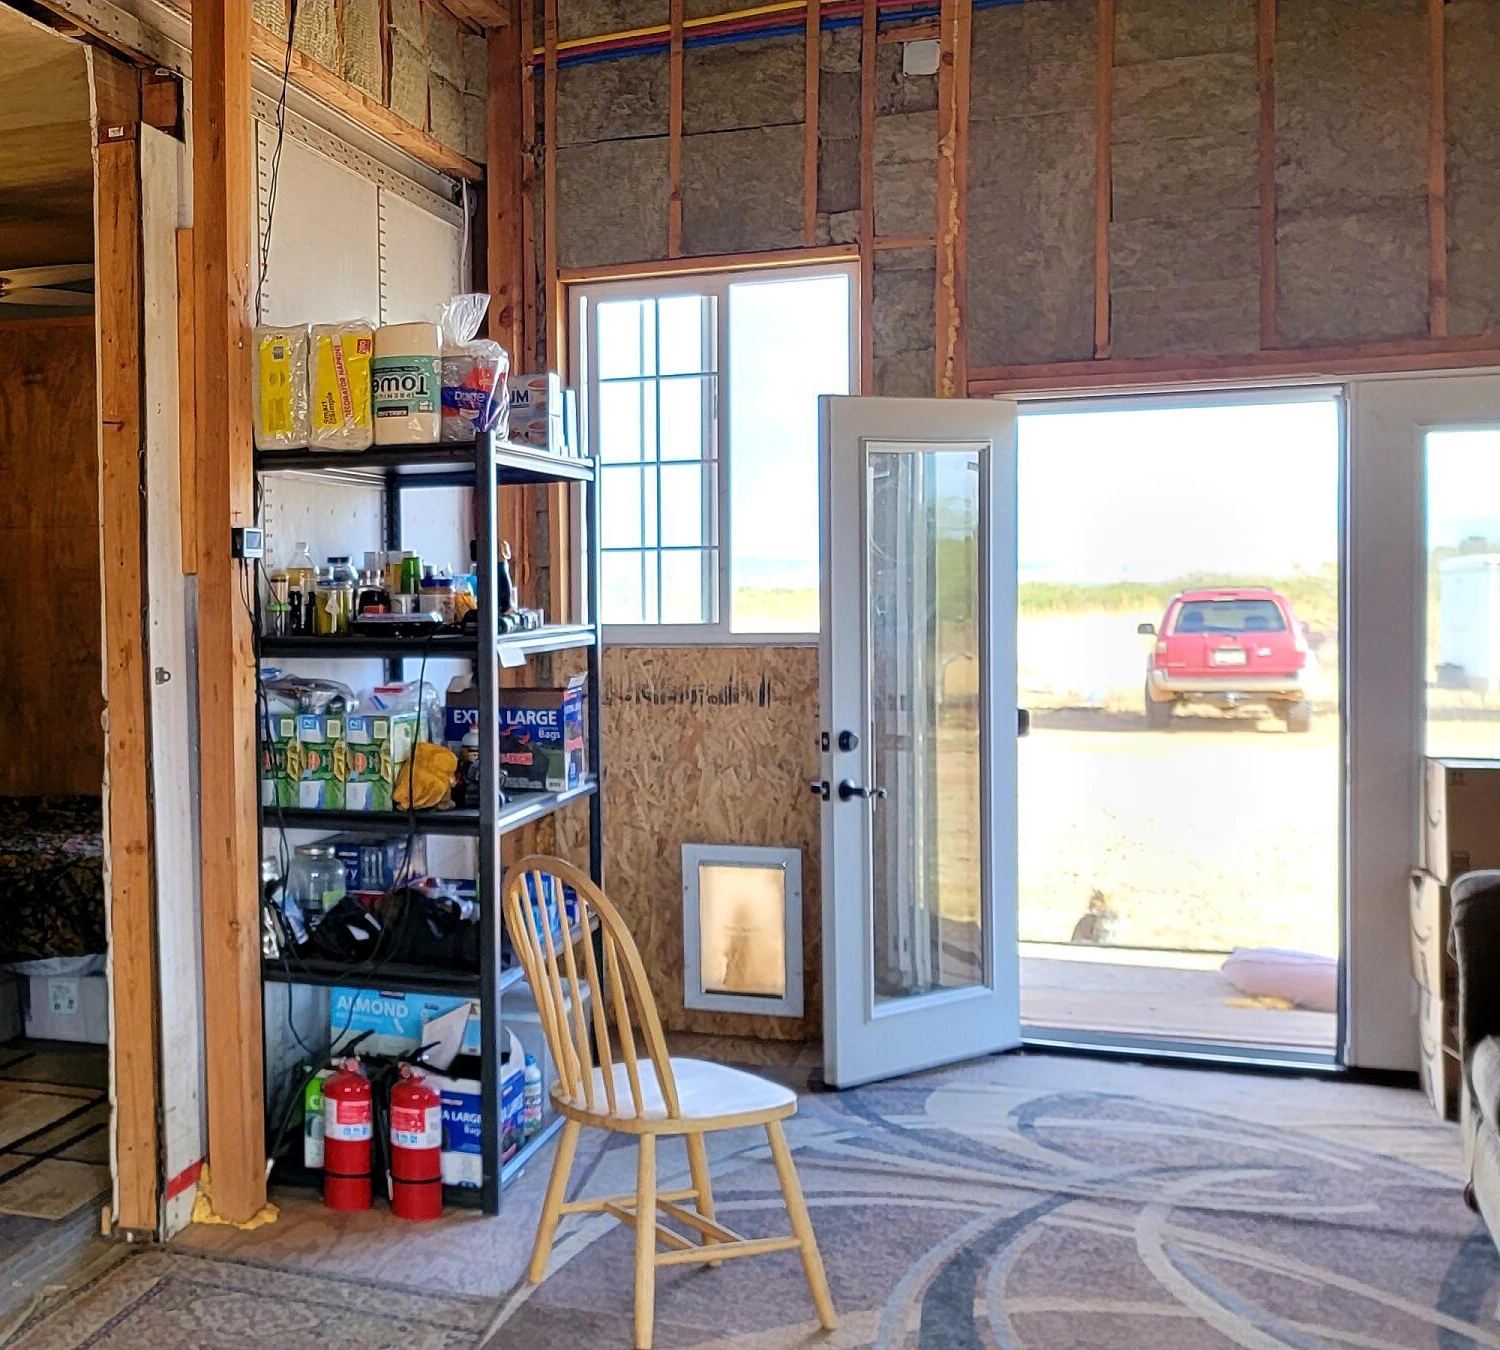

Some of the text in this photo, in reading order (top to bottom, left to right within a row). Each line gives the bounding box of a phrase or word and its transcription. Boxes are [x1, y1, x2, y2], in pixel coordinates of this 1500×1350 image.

[506, 710, 557, 725] LARGE
[538, 729, 560, 740] Bags
[336, 995, 409, 1018] ALMOND
